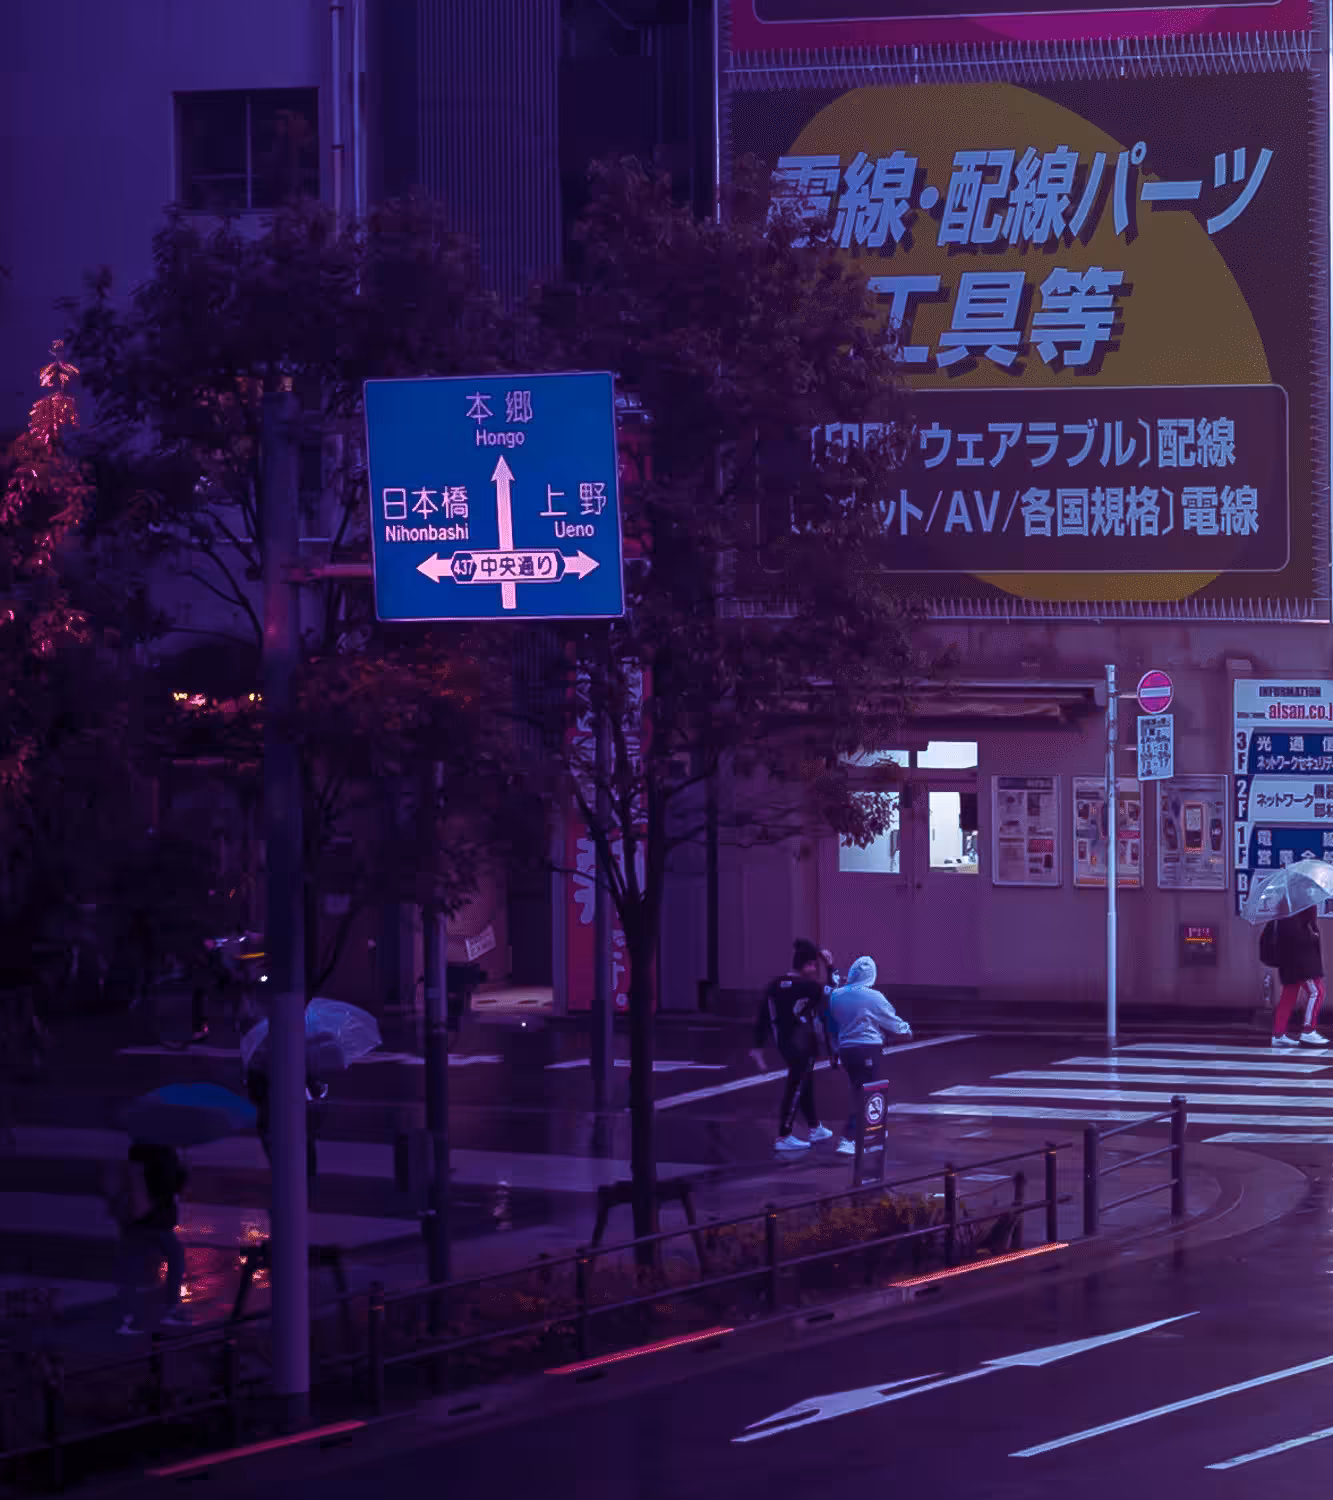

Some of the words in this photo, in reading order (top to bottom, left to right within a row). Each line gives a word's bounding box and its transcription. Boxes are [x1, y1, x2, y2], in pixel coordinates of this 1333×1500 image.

[466, 391, 533, 425] 本郷
[476, 430, 525, 449] Hongo
[383, 485, 469, 520] 日本橋
[540, 482, 606, 516] 上野
[385, 523, 470, 542] Nihonbashi
[555, 521, 595, 539] Ueno
[481, 556, 553, 577] 中央通り
